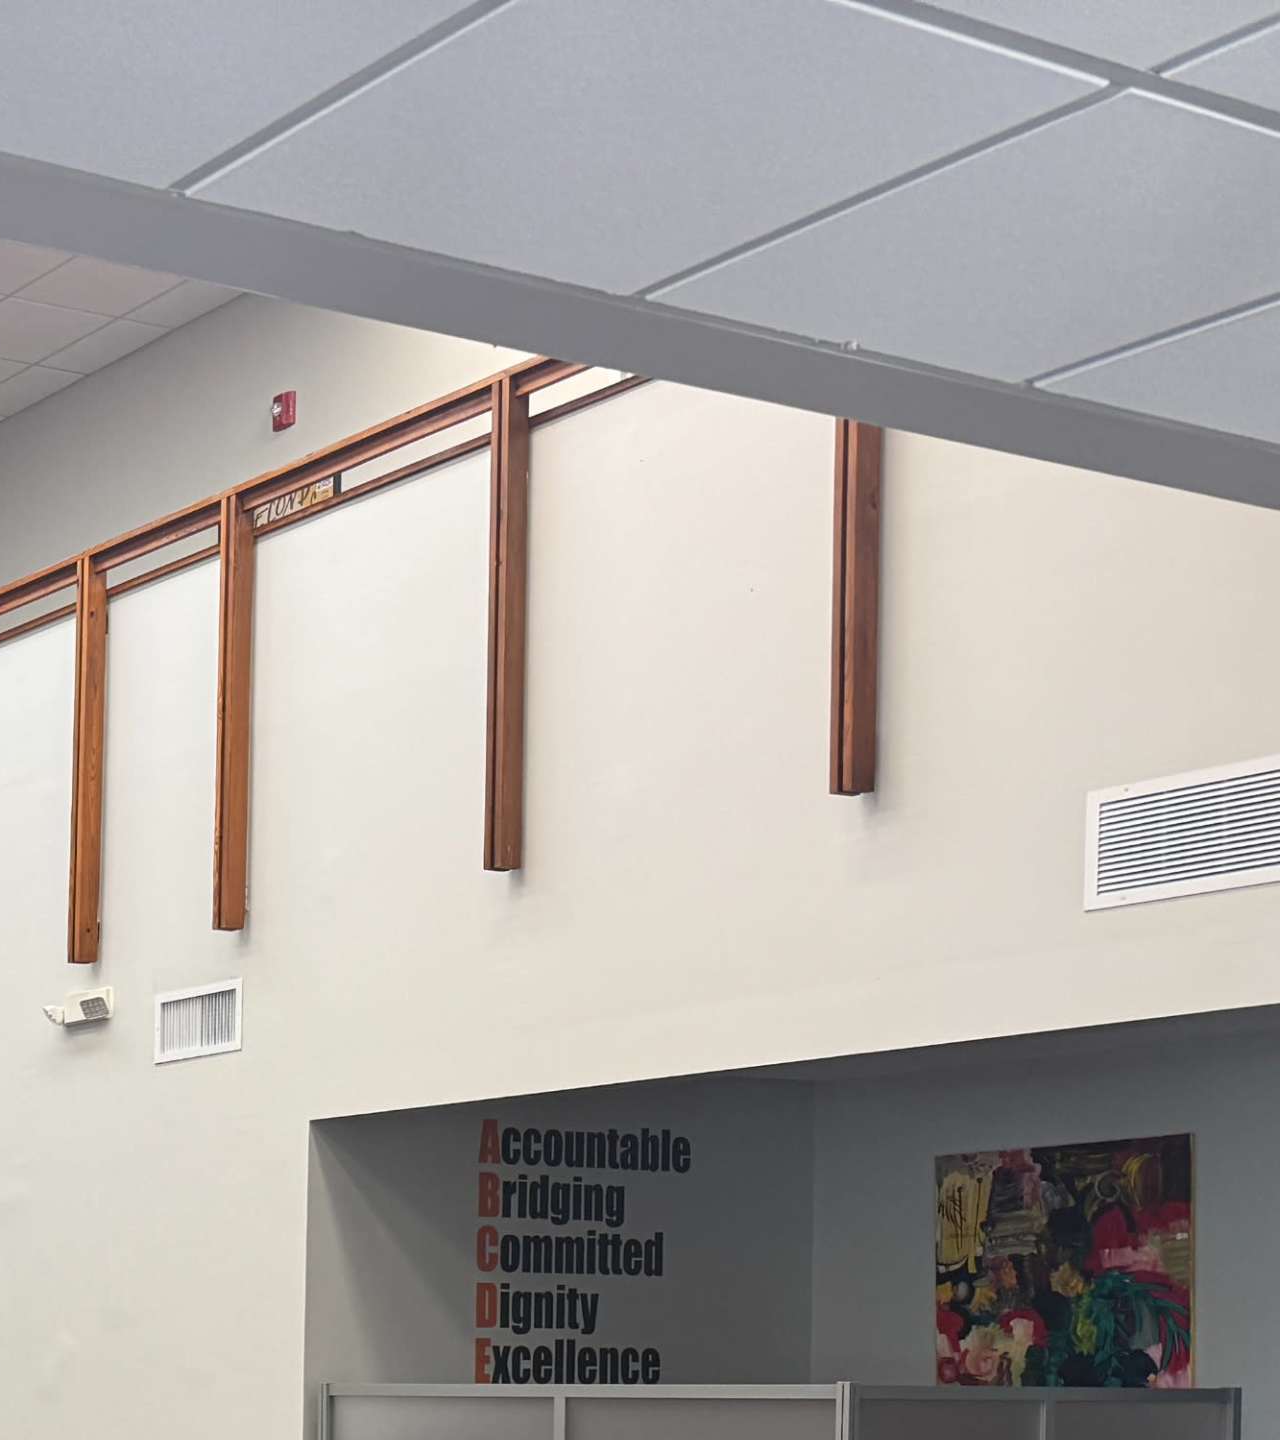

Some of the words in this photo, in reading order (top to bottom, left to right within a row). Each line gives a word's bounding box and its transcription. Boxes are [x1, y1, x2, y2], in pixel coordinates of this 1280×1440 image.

[478, 1118, 692, 1174] Accountable
[478, 1171, 625, 1228] Bridging
[476, 1225, 665, 1277] Committed
[475, 1281, 600, 1335] Dignity
[474, 1337, 661, 1385] Excellence
